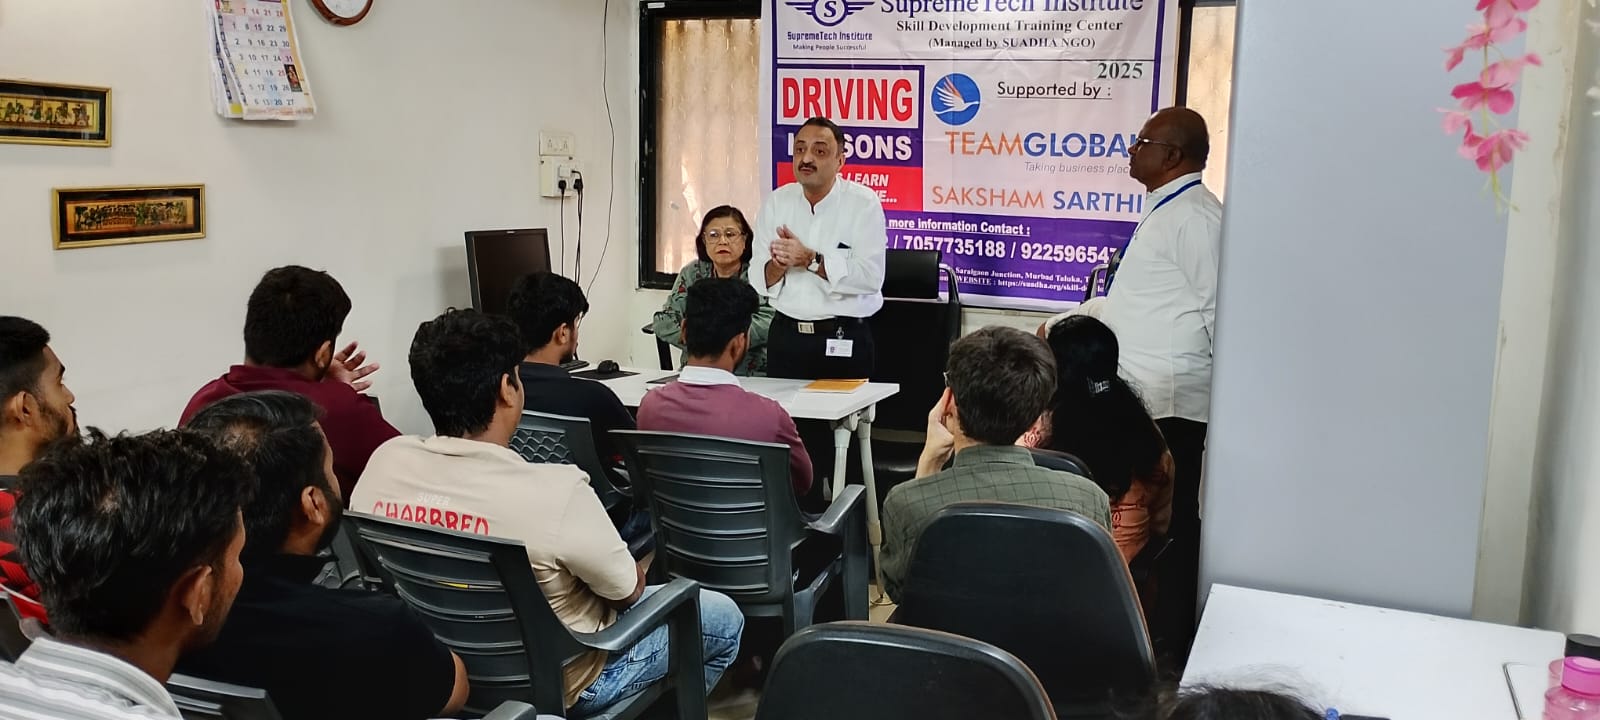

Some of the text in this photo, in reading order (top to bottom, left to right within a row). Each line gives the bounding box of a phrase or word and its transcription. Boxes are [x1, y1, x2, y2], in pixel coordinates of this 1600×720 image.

[823, 0, 837, 18] S
[896, 19, 1123, 33] Skill Development Training Center
[787, 31, 873, 42] SupremeTech Institute
[928, 37, 1096, 49] (Managed by SUADHA NGO)
[1097, 62, 1144, 79] 2025
[997, 81, 1077, 98] Supported
[1083, 82, 1101, 99] by
[782, 77, 913, 122] DRIVING
[1024, 161, 1130, 175] Taking business plac
[932, 185, 1142, 213] SAKSHAM SARTHI
[888, 219, 915, 229] more
[918, 218, 978, 232] information
[980, 221, 1024, 235] Contact
[902, 235, 1006, 258] 7057735188
[956, 275, 992, 285] WEBSITE
[990, 270, 1024, 279] Junction,
[1025, 272, 1054, 281] Murbad
